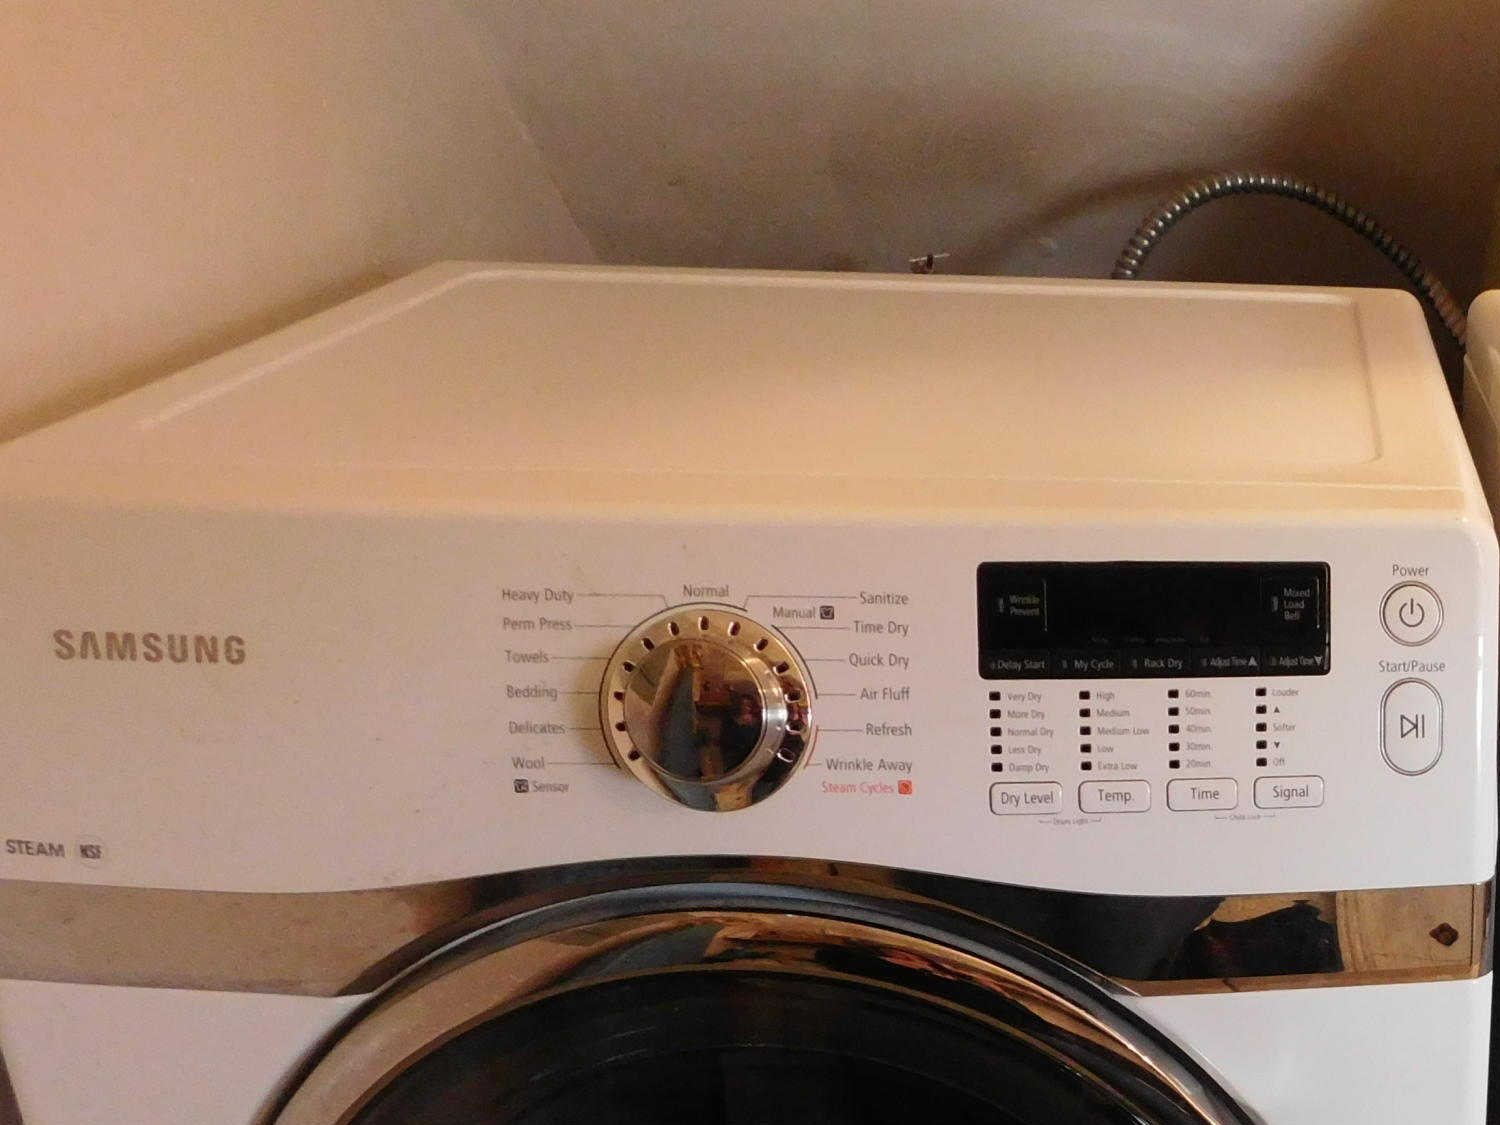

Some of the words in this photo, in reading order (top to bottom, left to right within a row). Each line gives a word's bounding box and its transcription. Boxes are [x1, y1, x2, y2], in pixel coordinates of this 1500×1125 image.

[1392, 564, 1429, 577] Power
[502, 589, 540, 602] Heavy
[544, 588, 574, 602] Duty
[683, 584, 729, 597] Normal
[1283, 588, 1310, 597] Mixed
[859, 592, 909, 605] Sanitize
[1284, 600, 1304, 608] Load
[772, 607, 816, 619] Manual
[503, 619, 535, 631] Perm
[538, 619, 572, 632] Press
[854, 621, 882, 634] Time
[887, 621, 909, 636] Dry
[53, 629, 246, 664] SAMSUNG
[504, 651, 549, 664] Towels
[849, 653, 882, 668] Quick
[886, 654, 909, 669] Dry
[997, 660, 1022, 671] Delay
[1024, 660, 1045, 669] Start
[1075, 660, 1089, 670] My
[1091, 659, 1114, 670] Cycle
[1145, 659, 1164, 668] Rack
[1167, 659, 1182, 670] Dry
[1379, 660, 1445, 673] Start/Pause
[507, 686, 558, 701] Bedding
[860, 688, 876, 700] Air
[880, 688, 910, 700] Fluff
[1008, 693, 1026, 702] Very
[1028, 692, 1041, 702] Dry
[1097, 692, 1115, 700] High
[1031, 710, 1045, 720] Dry
[1097, 709, 1130, 717] Medium
[508, 721, 566, 735] Delicates
[866, 723, 912, 736] Refresh
[1008, 728, 1038, 736] Normal
[1040, 728, 1054, 738] Dry
[1097, 727, 1130, 735] Medium
[1133, 727, 1149, 735] Low
[1273, 723, 1295, 731] Softer
[1008, 746, 1025, 754] Less
[1028, 746, 1041, 755] Dry
[1098, 745, 1113, 753] Low
[512, 757, 545, 769] Wool
[826, 759, 873, 772] Wrinkle
[877, 759, 912, 773] Away
[1009, 764, 1033, 773] Damp
[1036, 763, 1049, 773] Dry
[1121, 762, 1137, 770] Low
[1273, 758, 1285, 766] Off
[532, 781, 568, 794] Sensor
[822, 781, 856, 794] Steam
[859, 782, 895, 796] Cycles
[1272, 785, 1309, 801] Signal
[1001, 792, 1020, 807] Dry
[1024, 792, 1054, 804] Level
[1190, 788, 1220, 800] Time
[6, 839, 64, 858] STEAM
